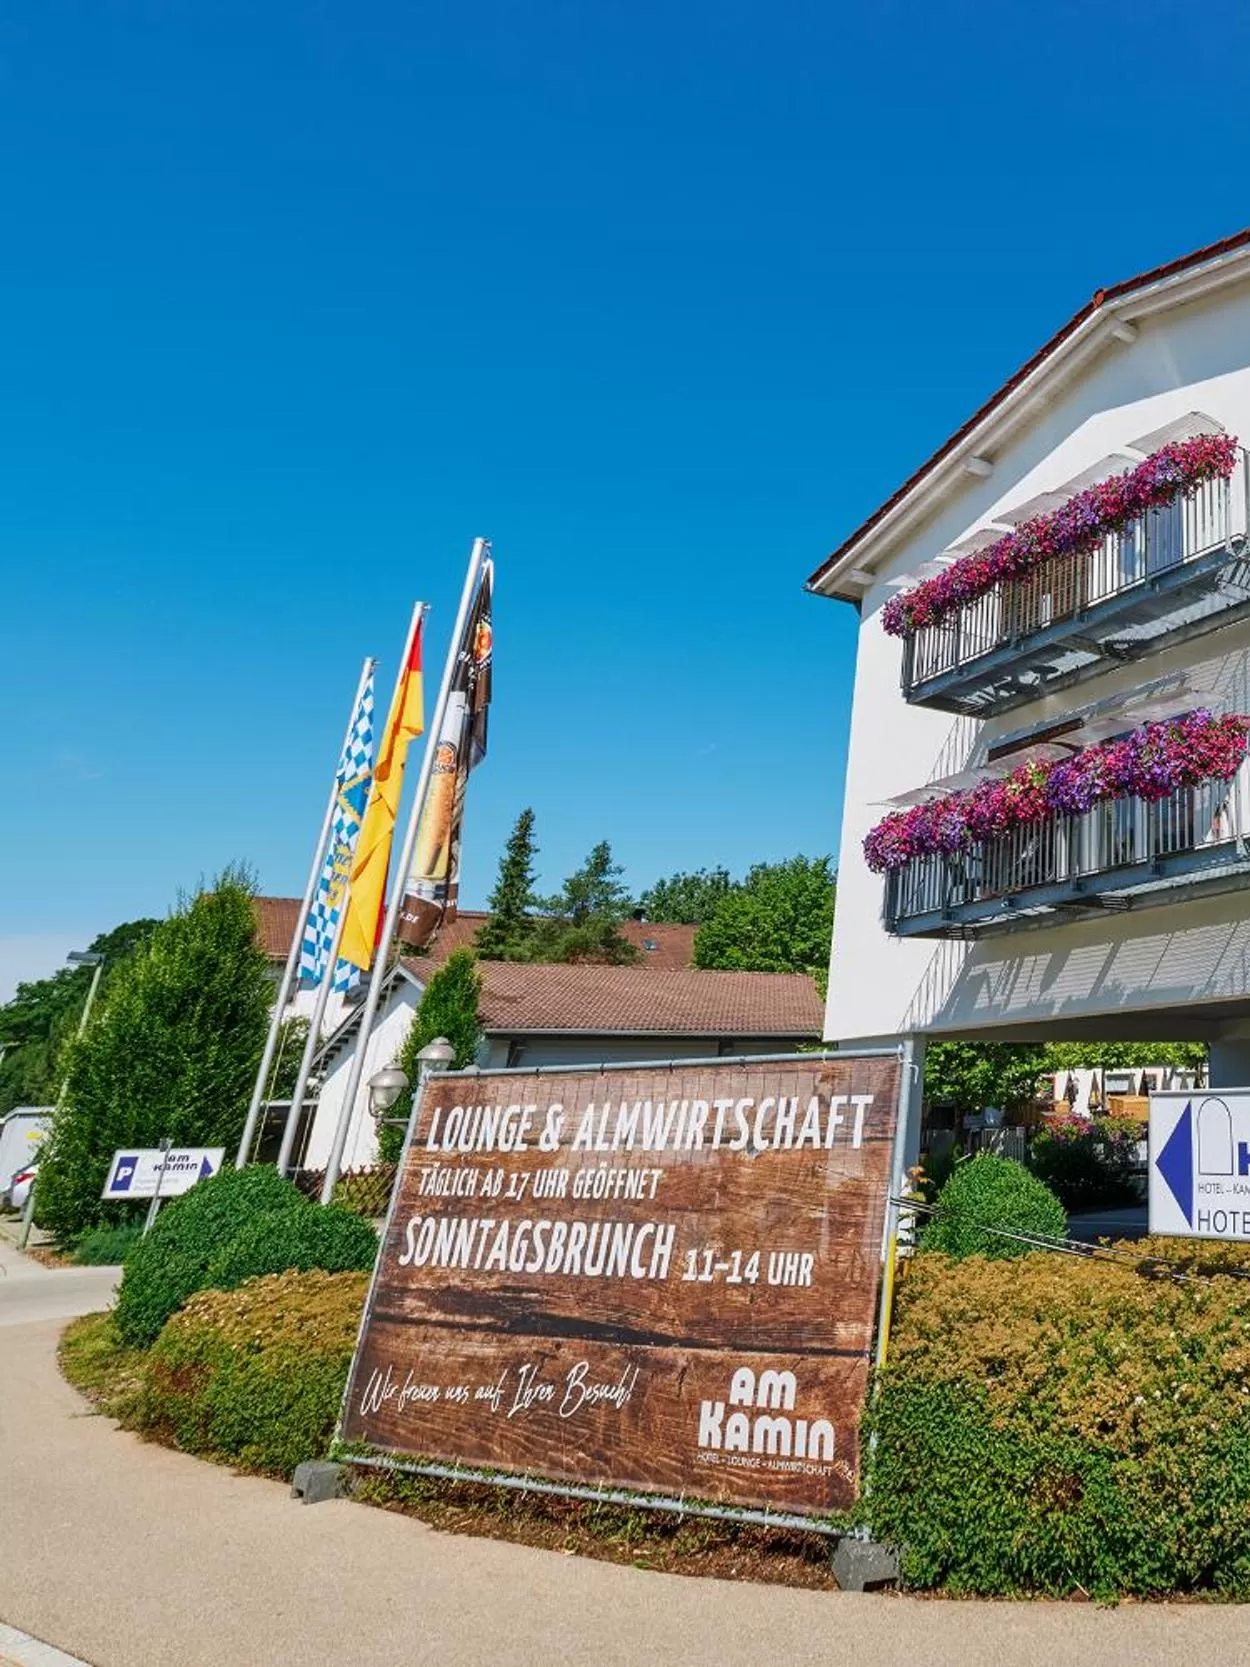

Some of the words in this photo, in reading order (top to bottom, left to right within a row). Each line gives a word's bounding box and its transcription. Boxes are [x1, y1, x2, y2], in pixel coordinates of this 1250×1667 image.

[426, 1104, 537, 1152] LOUNGE
[538, 1103, 567, 1152] &
[571, 1094, 874, 1152] ALMWIRTSCHAFT
[418, 1163, 478, 1198] TÄGLICH
[480, 1168, 504, 1198] AB
[504, 1172, 531, 1201] 17
[532, 1168, 569, 1199] UHR
[572, 1161, 663, 1200] GEÖFFNET
[1198, 1183, 1224, 1195] HOTEL
[398, 1216, 677, 1280] SONNTAGSBRUNCH
[767, 1251, 814, 1287] UHR
[360, 1364, 399, 1416] Wir
[397, 1369, 440, 1412] freuen
[445, 1384, 470, 1404] uns
[474, 1369, 508, 1412] auf
[507, 1363, 556, 1418] Ihren
[728, 1366, 797, 1411] AM
[698, 1400, 835, 1461] KAMIN
